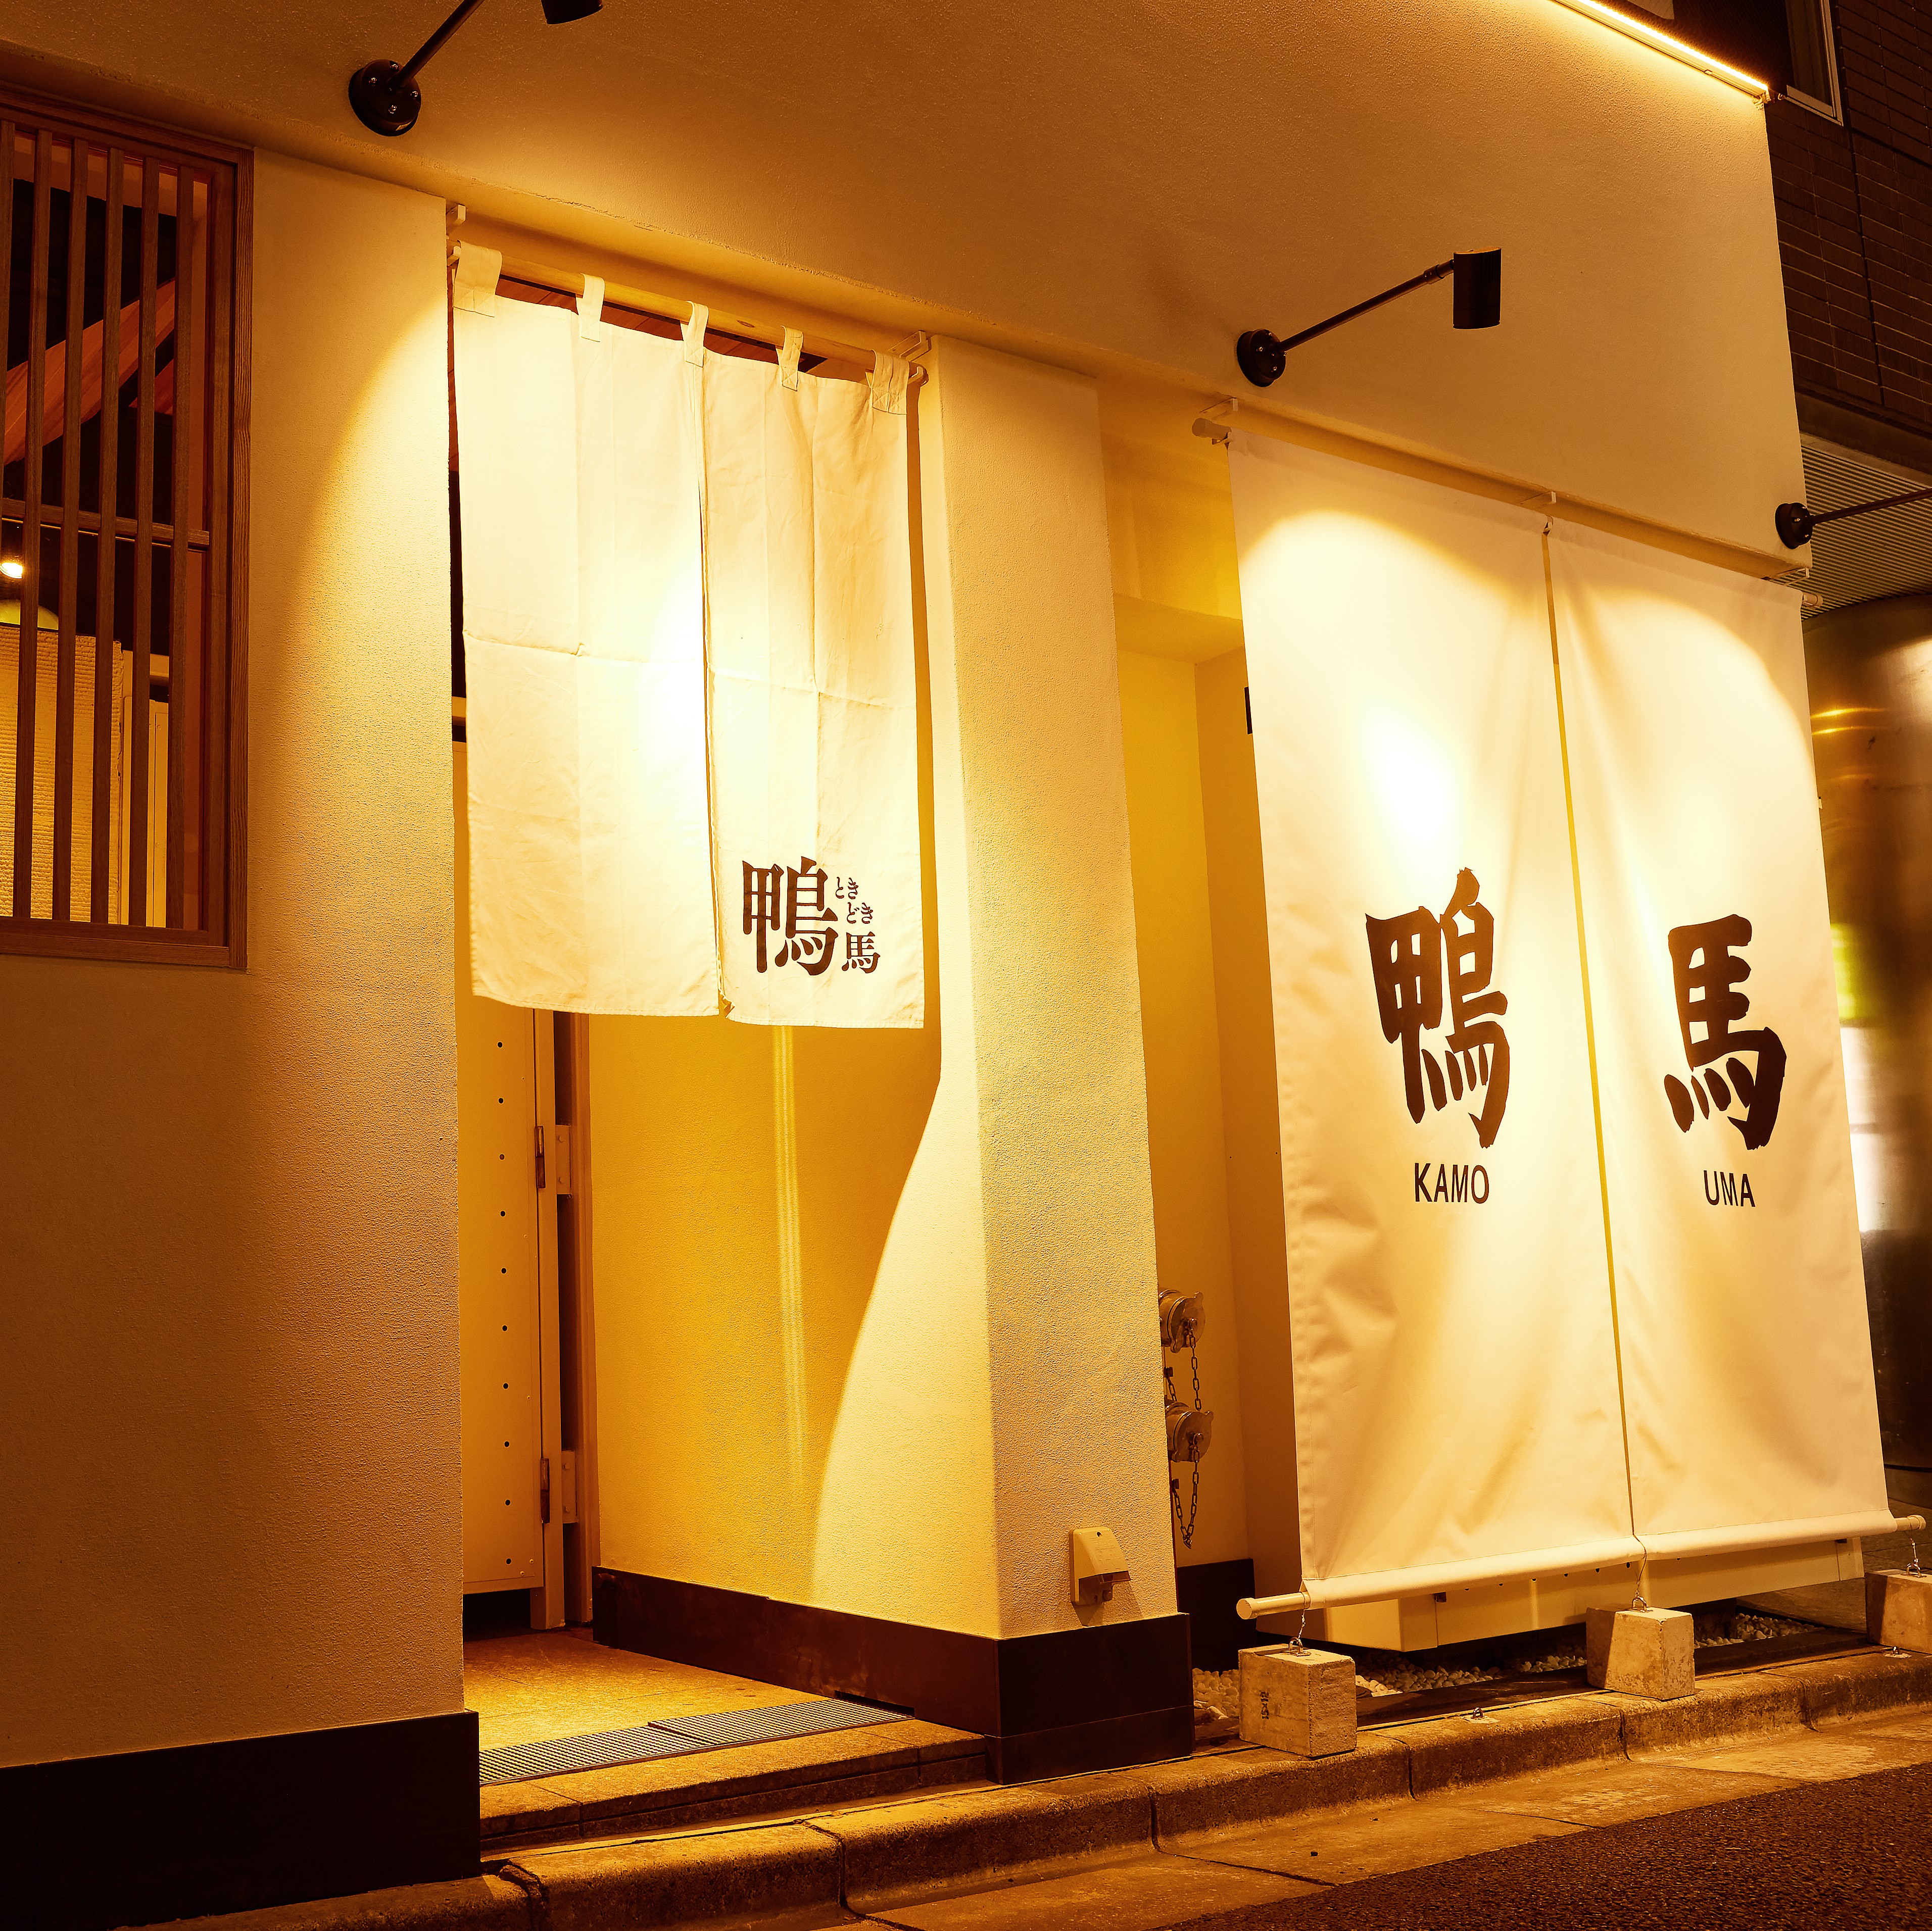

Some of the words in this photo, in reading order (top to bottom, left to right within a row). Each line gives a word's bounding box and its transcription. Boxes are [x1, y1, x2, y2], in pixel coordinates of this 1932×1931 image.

[742, 856, 839, 975] 鴨
[842, 931, 880, 973] 馬
[1365, 867, 1510, 1149] 鴨
[1664, 914, 1786, 1150] 馬
[1415, 1163, 1489, 1204] KAMO
[1704, 1170, 1756, 1207] UMA
